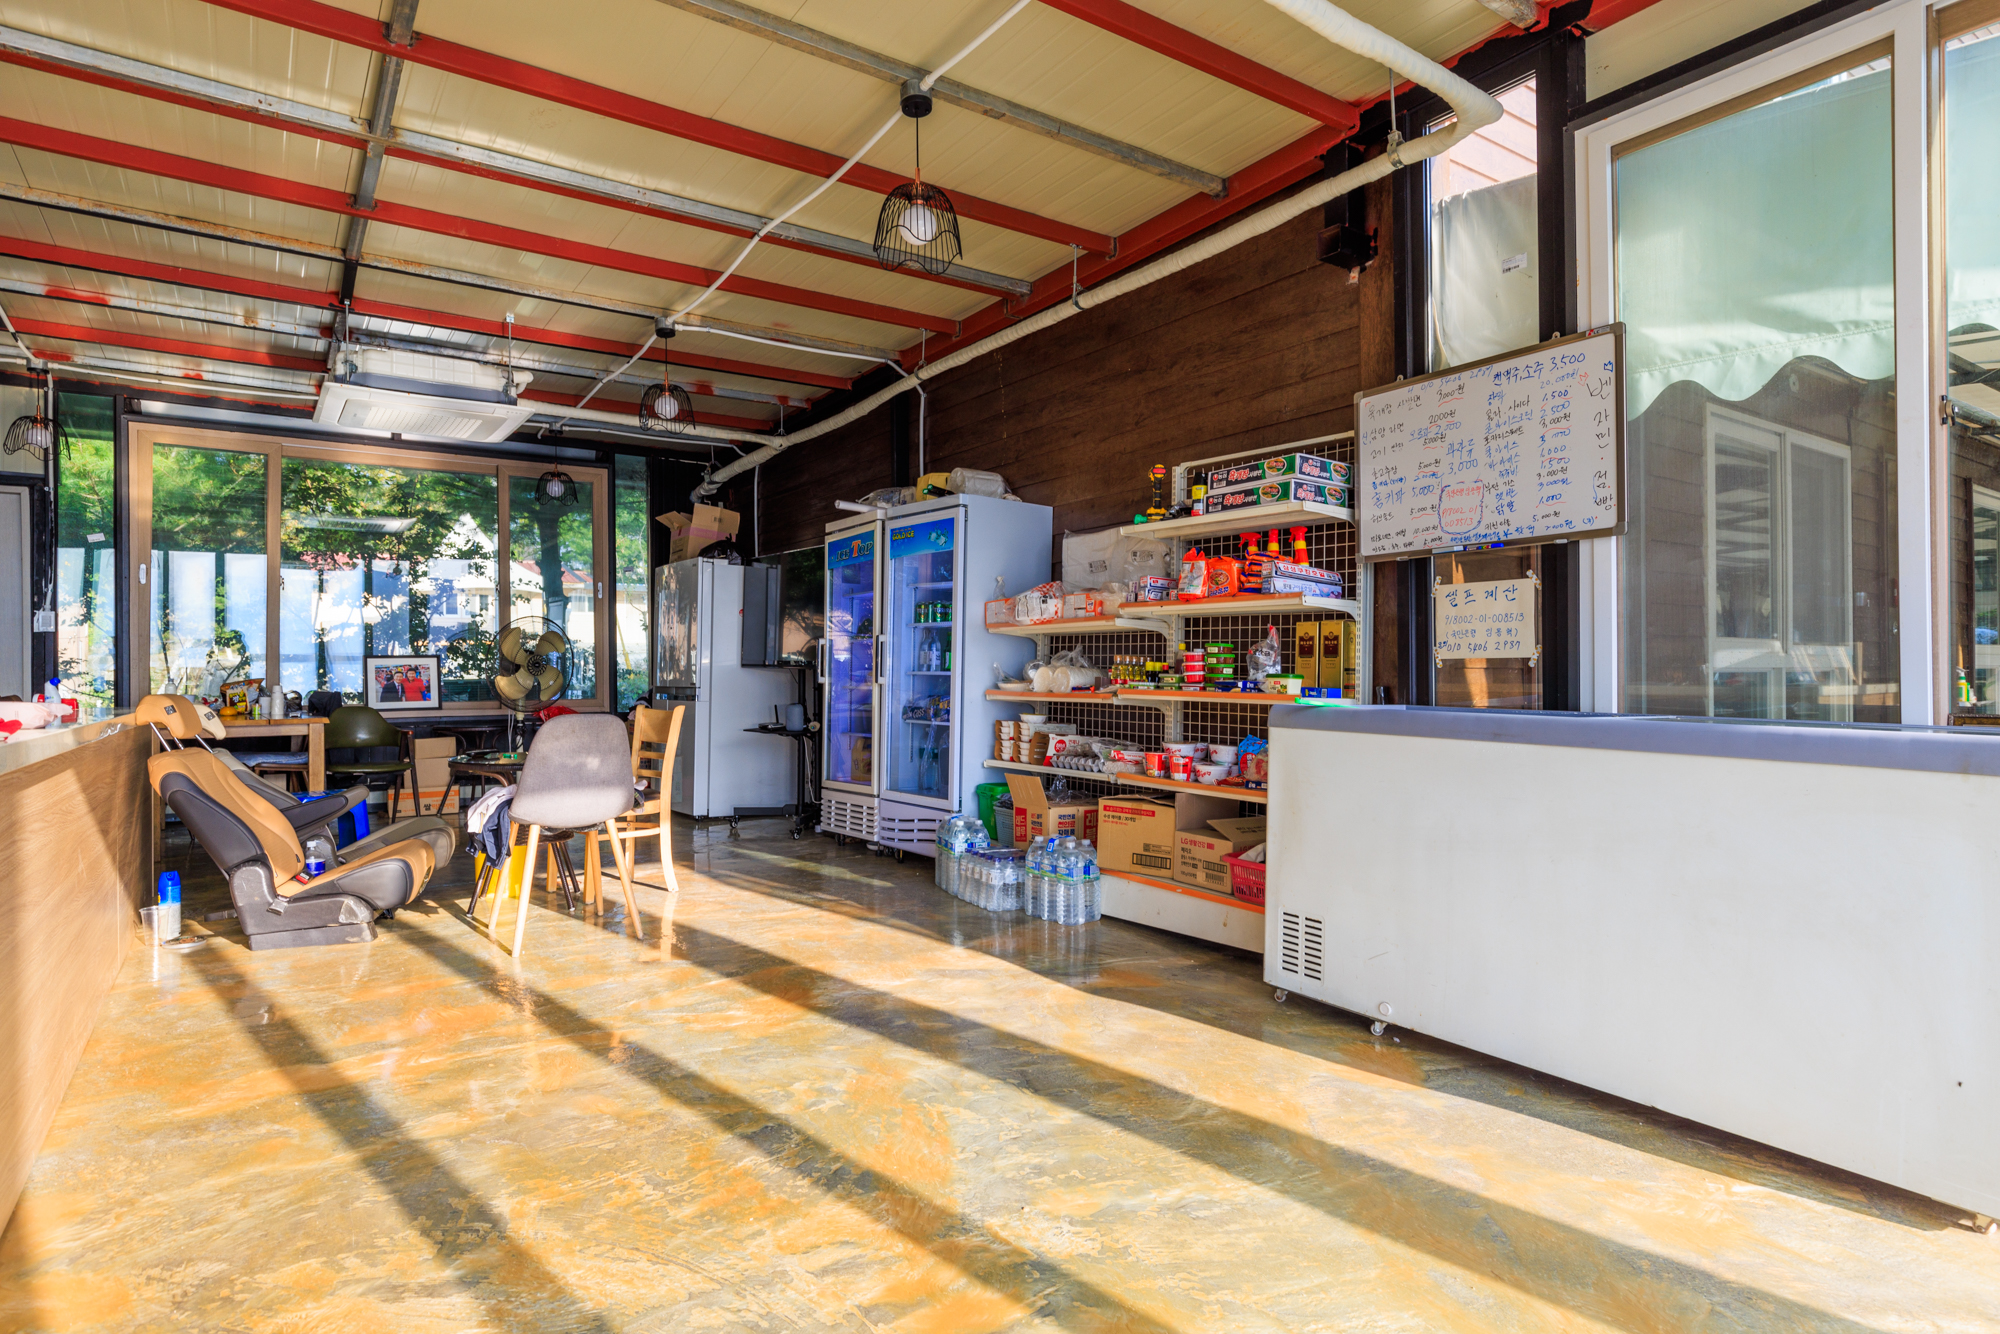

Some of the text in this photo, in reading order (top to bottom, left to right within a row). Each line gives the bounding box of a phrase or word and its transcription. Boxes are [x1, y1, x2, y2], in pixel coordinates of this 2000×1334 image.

[1508, 394, 1531, 411] 사이다
[1389, 422, 1404, 434] 라면
[1228, 468, 1249, 481] 육개장
[1223, 493, 1245, 506] 육개장
[892, 530, 915, 541] GOLD ICE
[836, 540, 874, 561] ICE TOP
